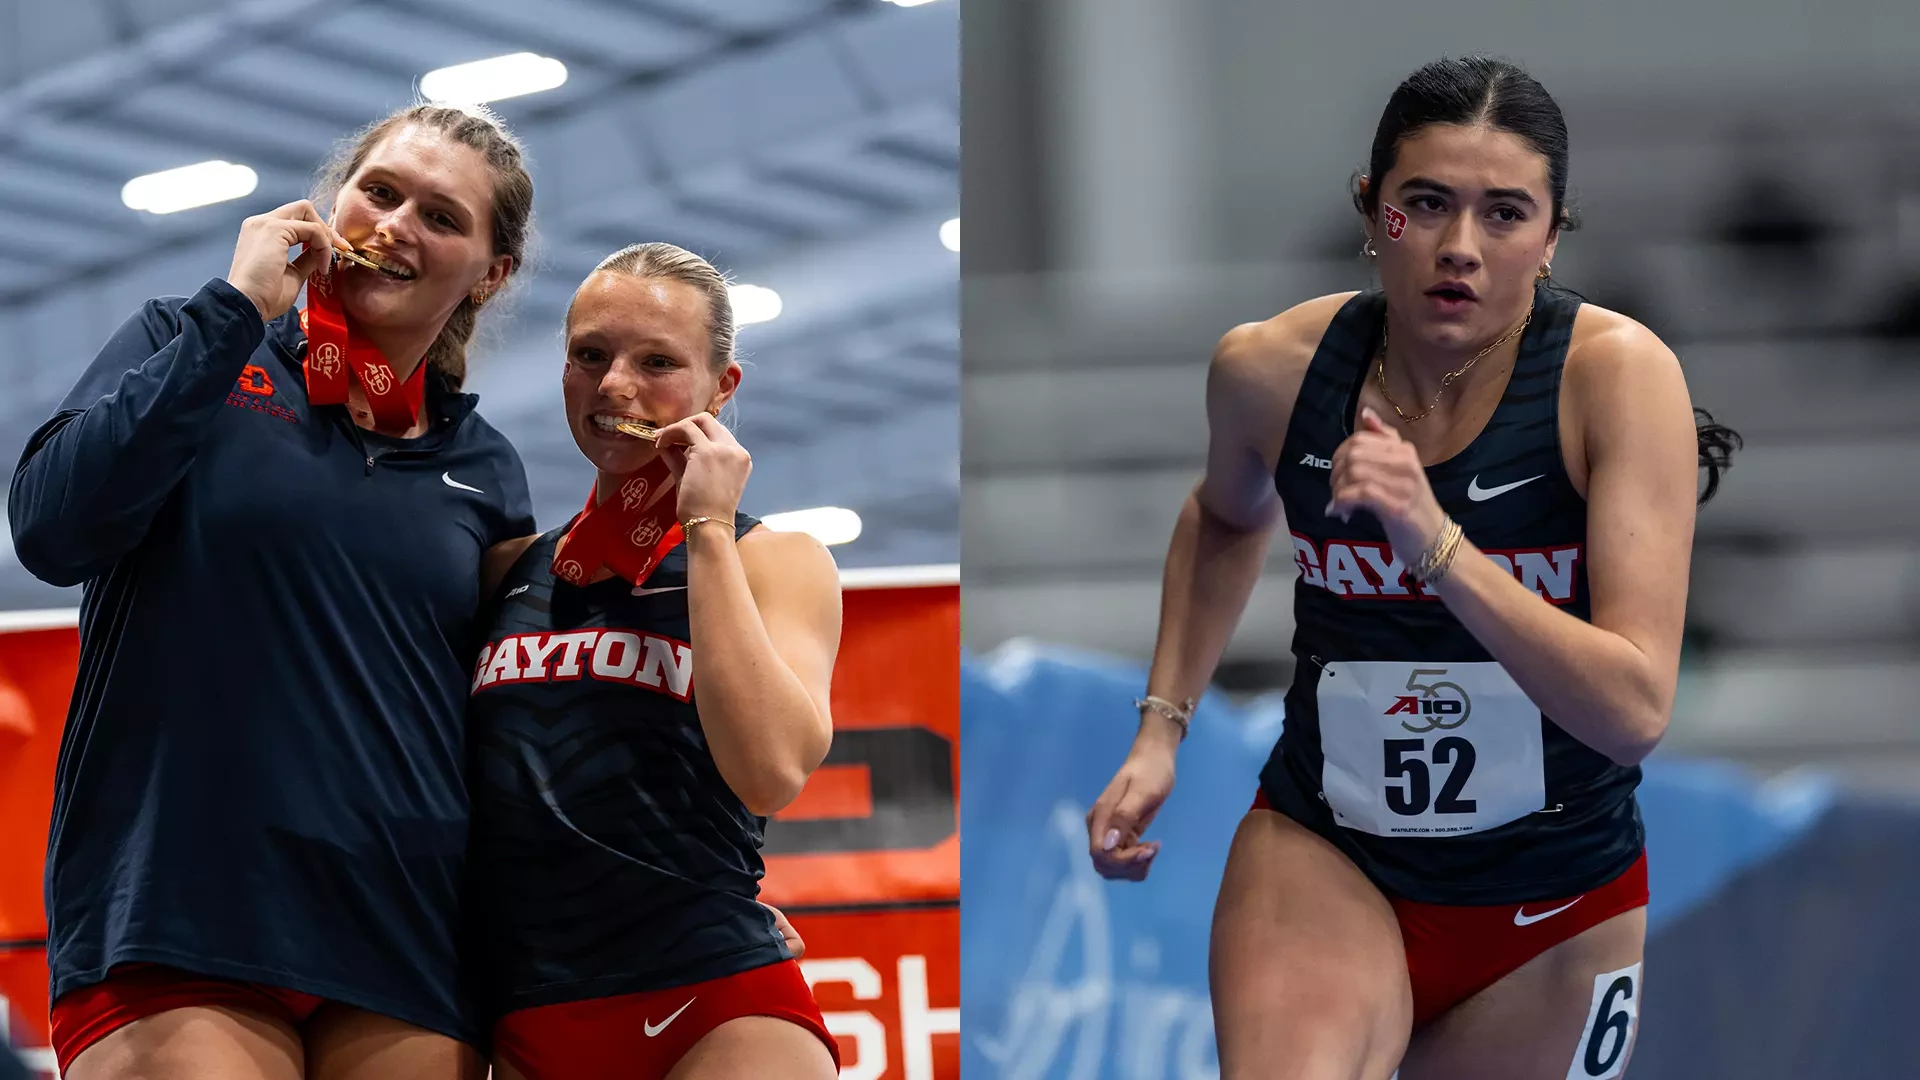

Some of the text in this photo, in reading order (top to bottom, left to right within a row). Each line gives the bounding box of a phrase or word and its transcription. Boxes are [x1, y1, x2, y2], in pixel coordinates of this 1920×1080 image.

[1299, 453, 1332, 470] A10
[1290, 536, 1579, 600] DAYN
[1383, 695, 1462, 715] A10
[1384, 736, 1477, 816] 52
[1584, 975, 1634, 1077] 6
